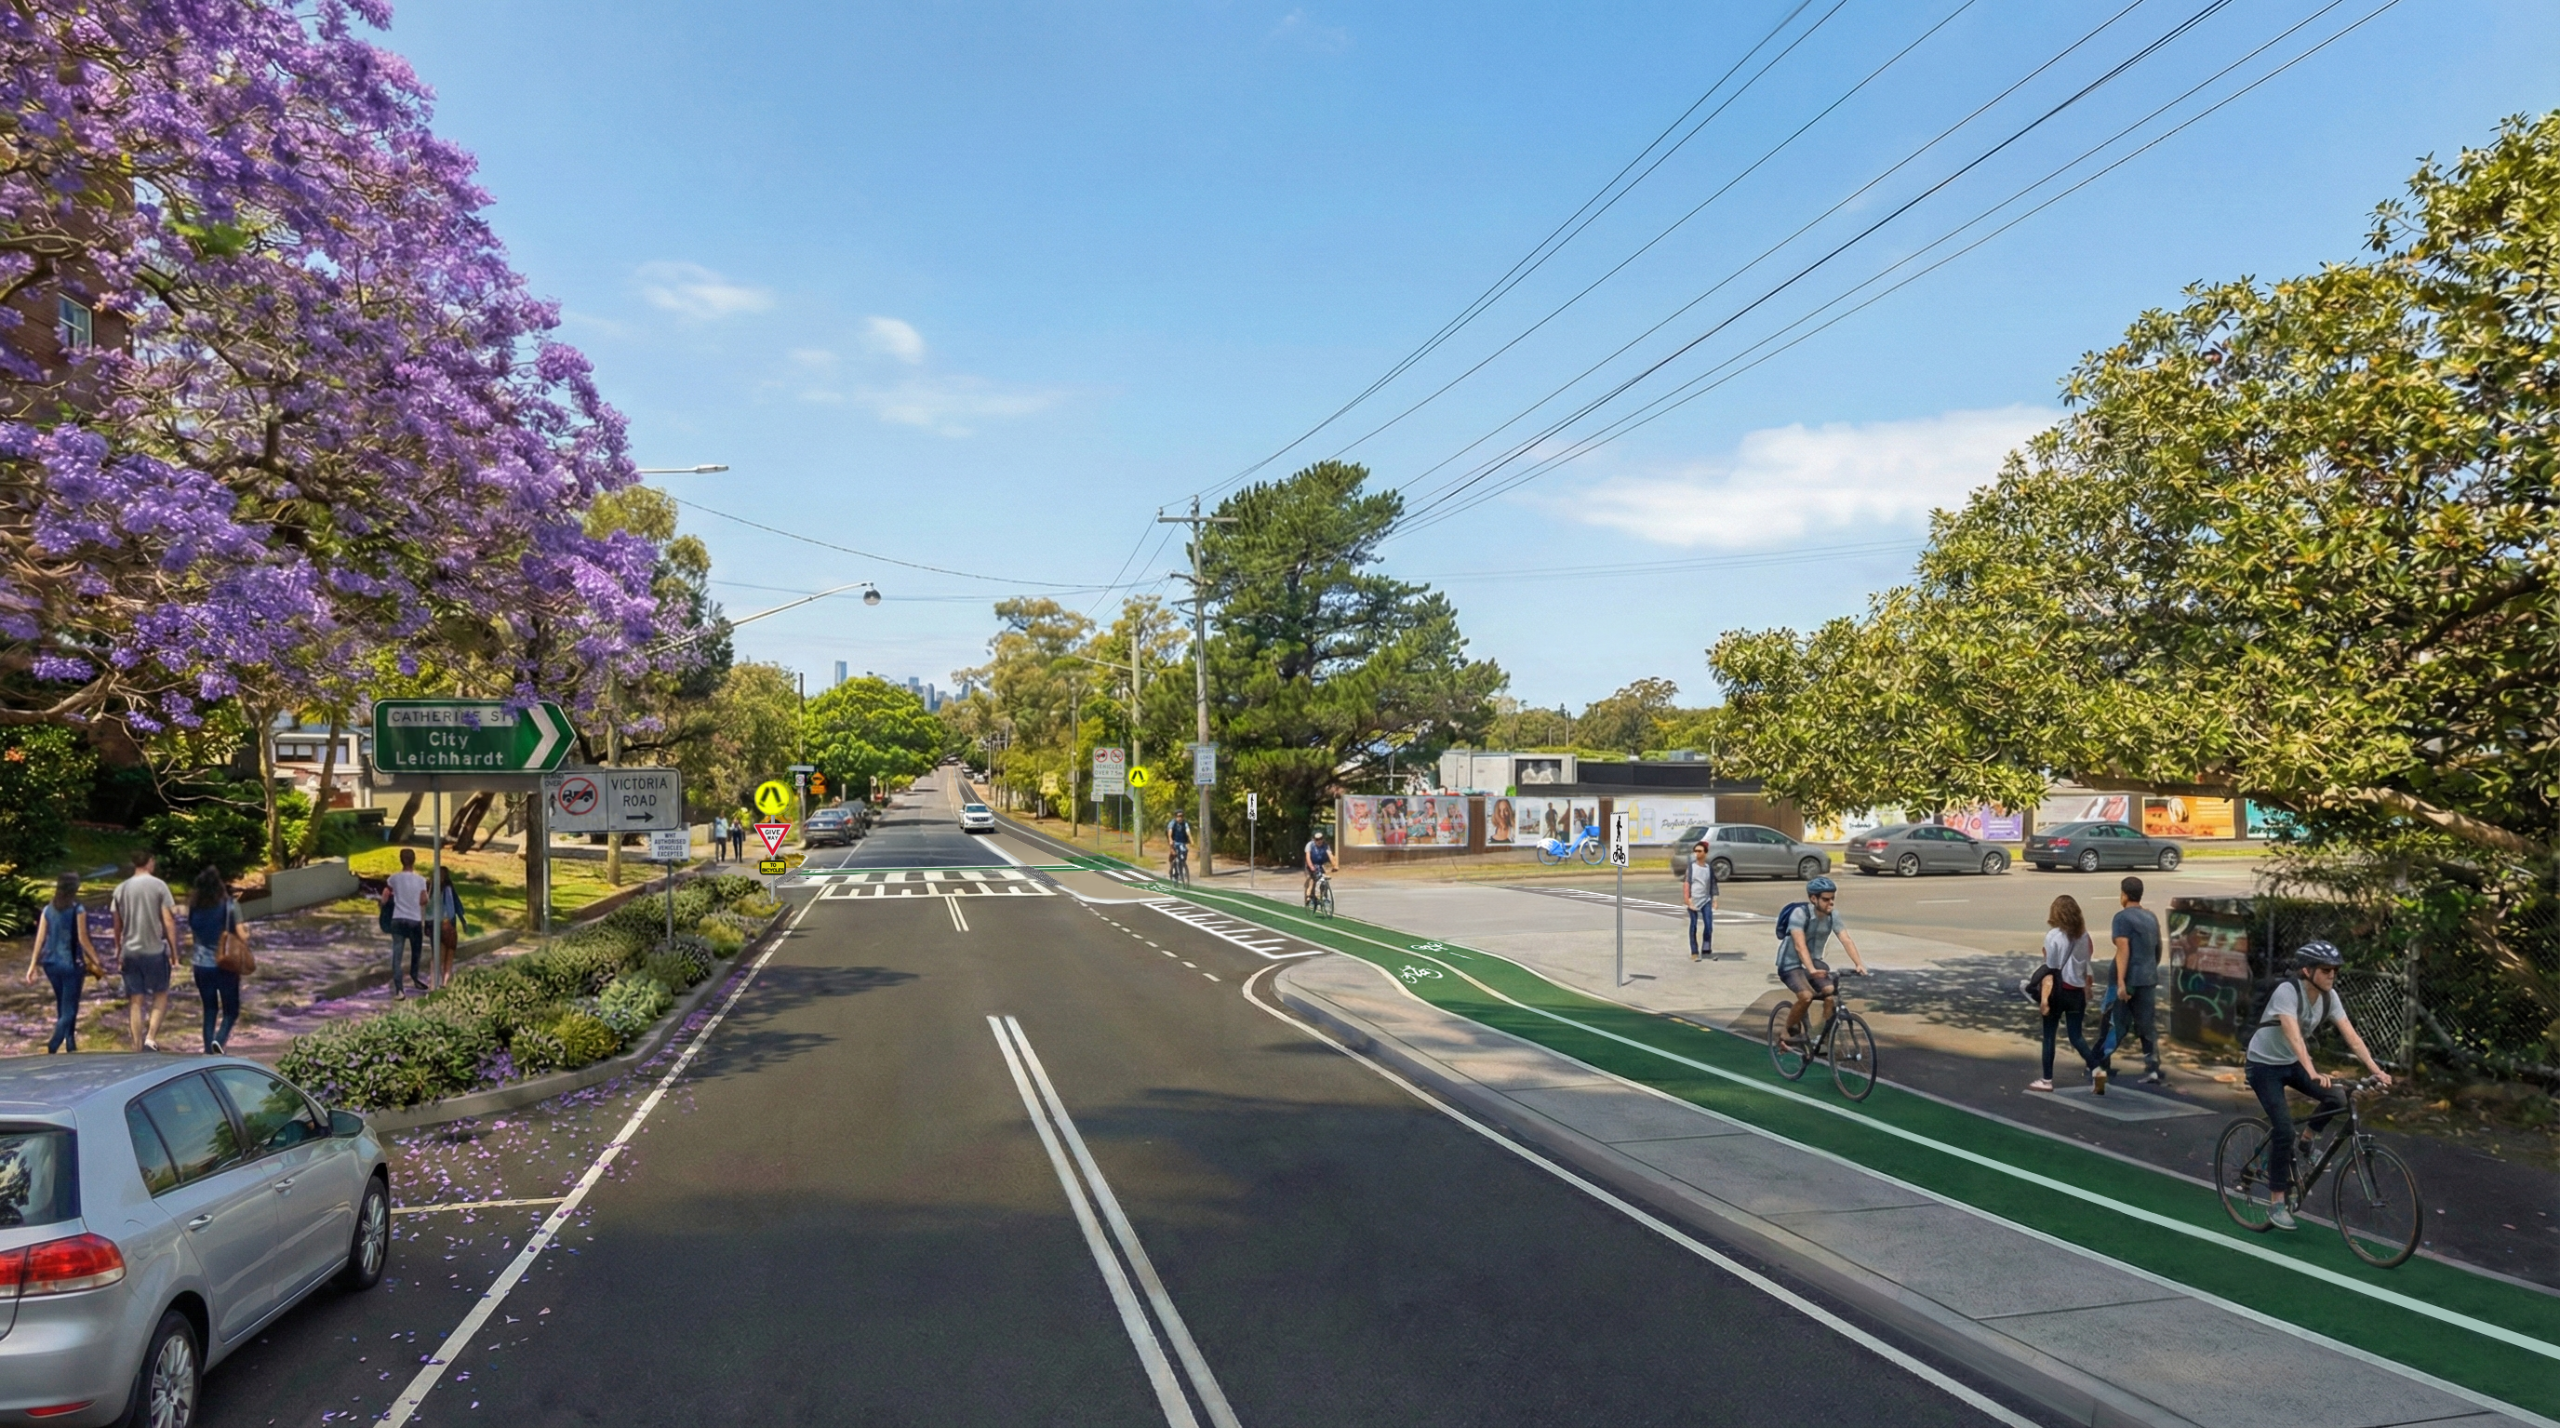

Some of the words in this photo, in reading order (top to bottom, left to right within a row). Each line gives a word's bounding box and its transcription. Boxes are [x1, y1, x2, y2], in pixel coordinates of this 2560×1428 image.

[392, 711, 481, 722] CATHERIE
[429, 732, 469, 749] City
[396, 752, 503, 765] Leichhardt
[611, 777, 668, 790] VICTORIA
[623, 794, 657, 807] ROAD
